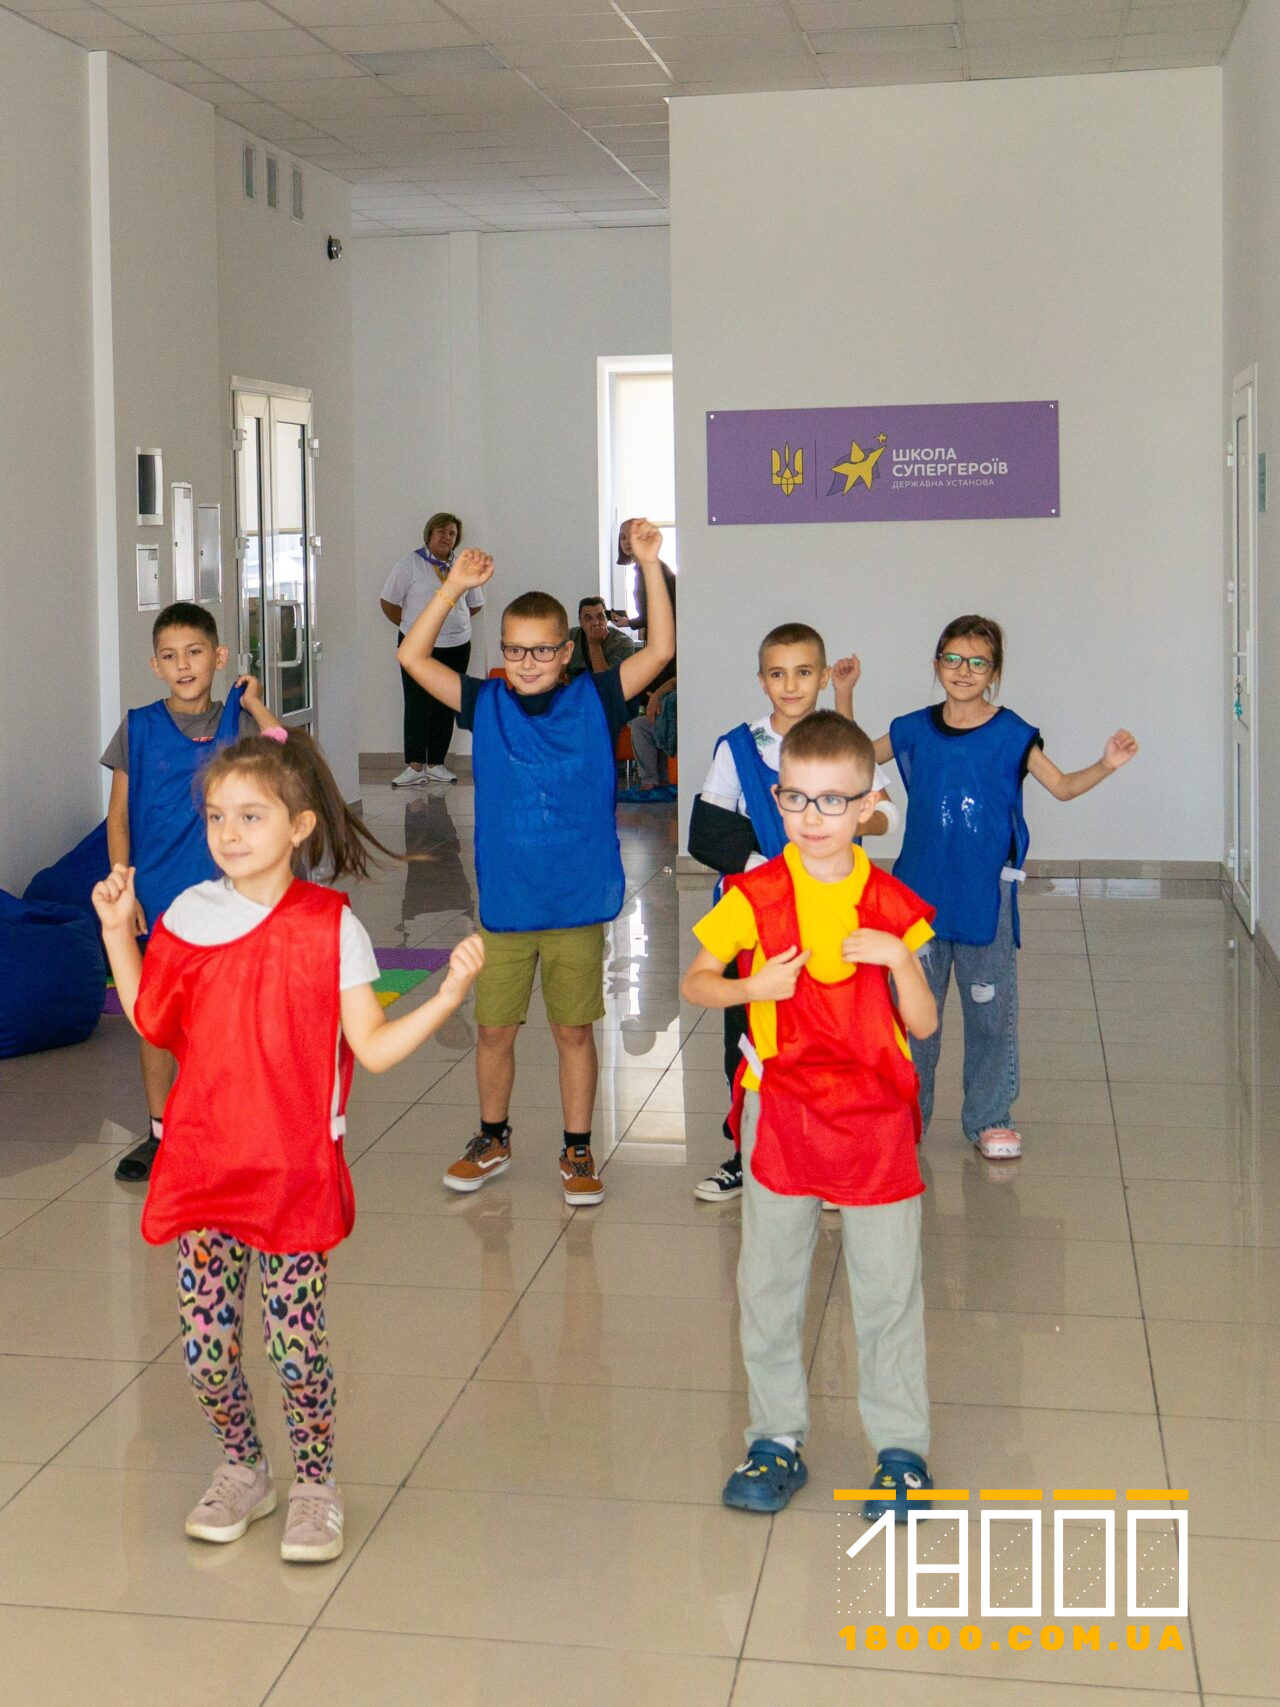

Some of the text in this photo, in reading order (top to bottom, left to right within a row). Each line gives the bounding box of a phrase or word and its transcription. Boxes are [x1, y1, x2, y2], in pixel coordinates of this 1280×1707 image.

[892, 447, 957, 461] ШКОЛА
[892, 458, 1008, 477] СУПЕРГЕРОЇВ
[892, 478, 995, 490] ДЕРЖАВНА УСТАНОВА
